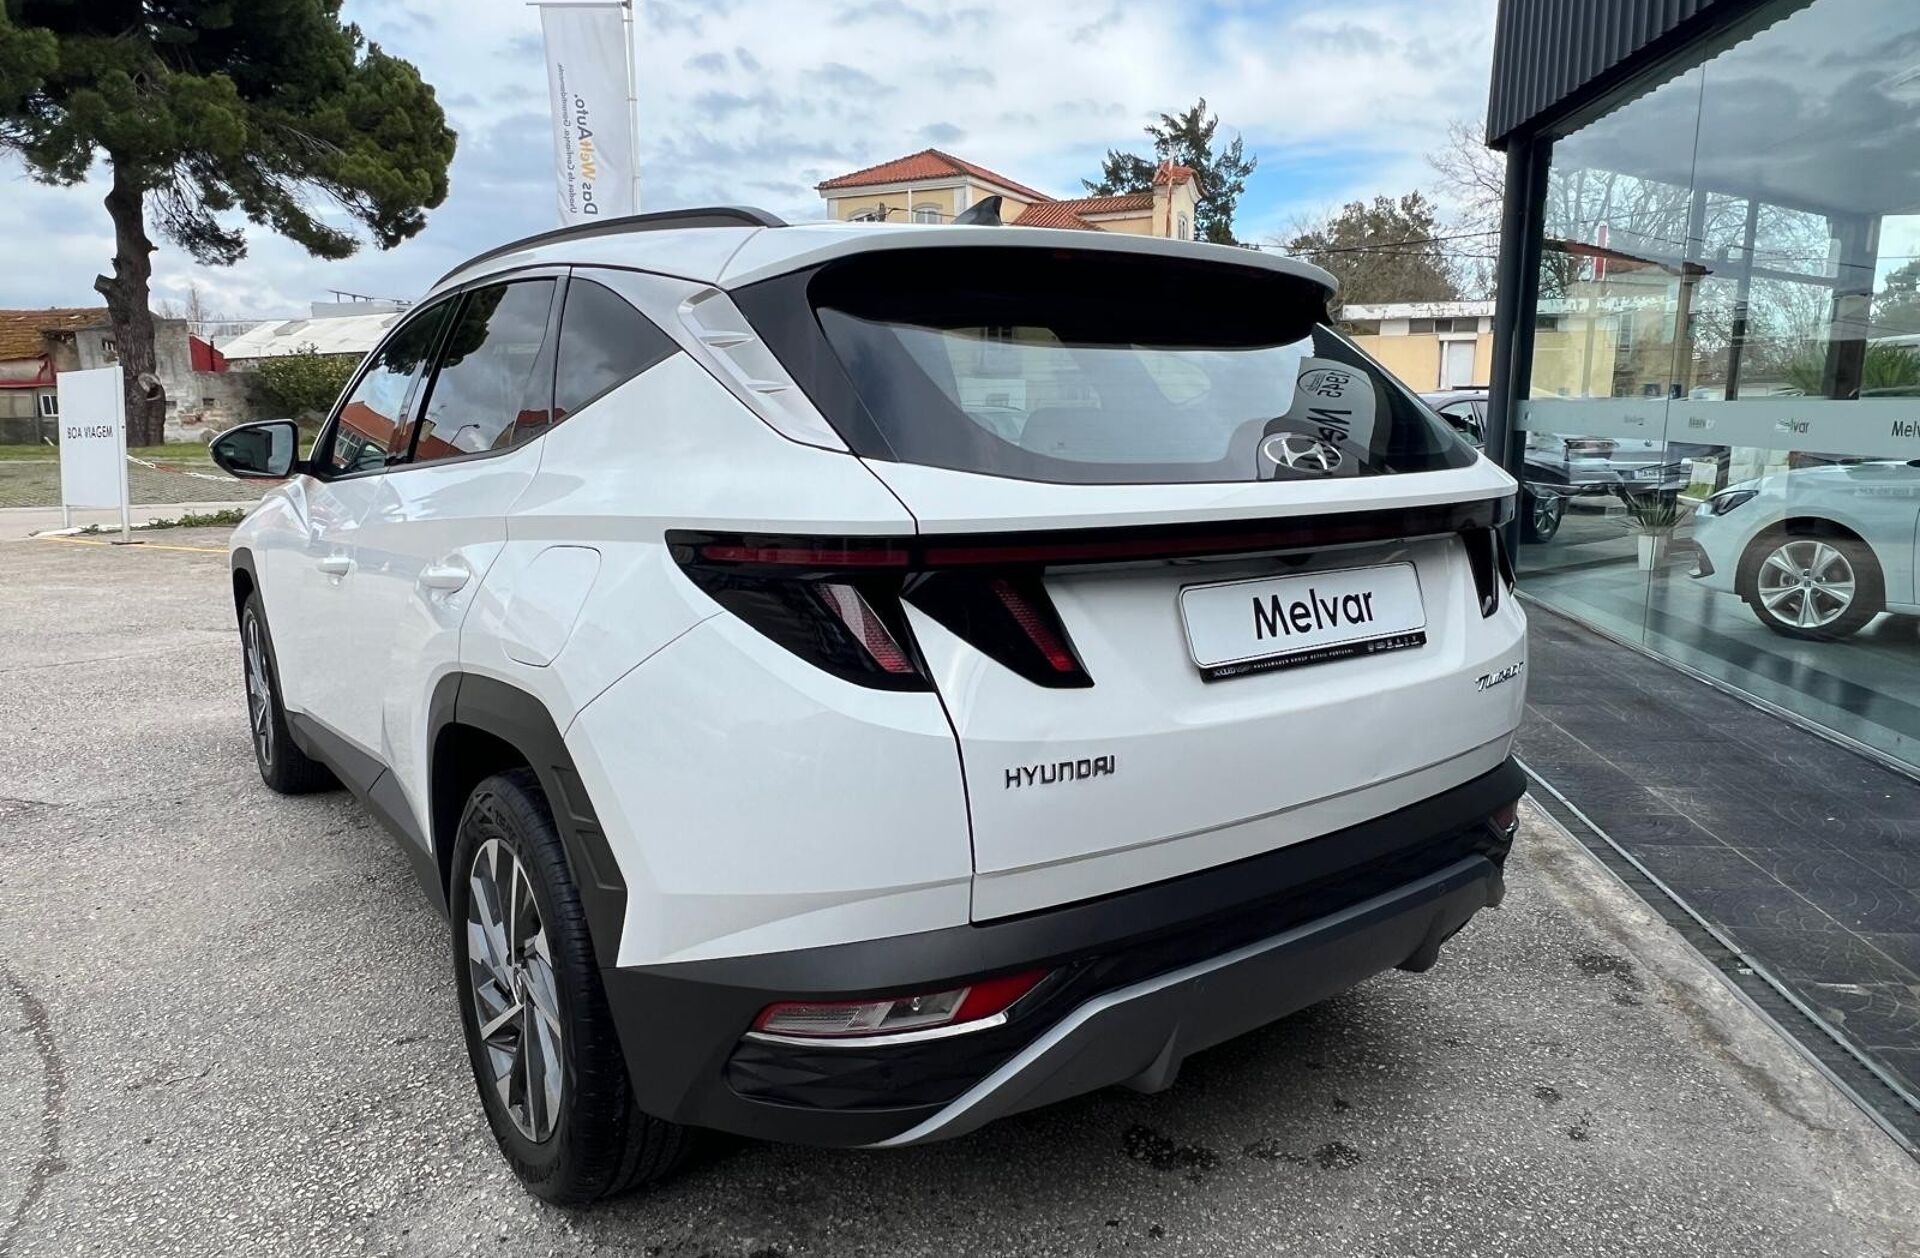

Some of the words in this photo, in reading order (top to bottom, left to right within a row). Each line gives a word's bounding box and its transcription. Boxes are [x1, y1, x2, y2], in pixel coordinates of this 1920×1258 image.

[67, 427, 82, 439] BOA
[84, 425, 113, 439] VIAGEM
[1253, 588, 1373, 640] Melvar
[1005, 755, 1115, 789] HYUNDAI
